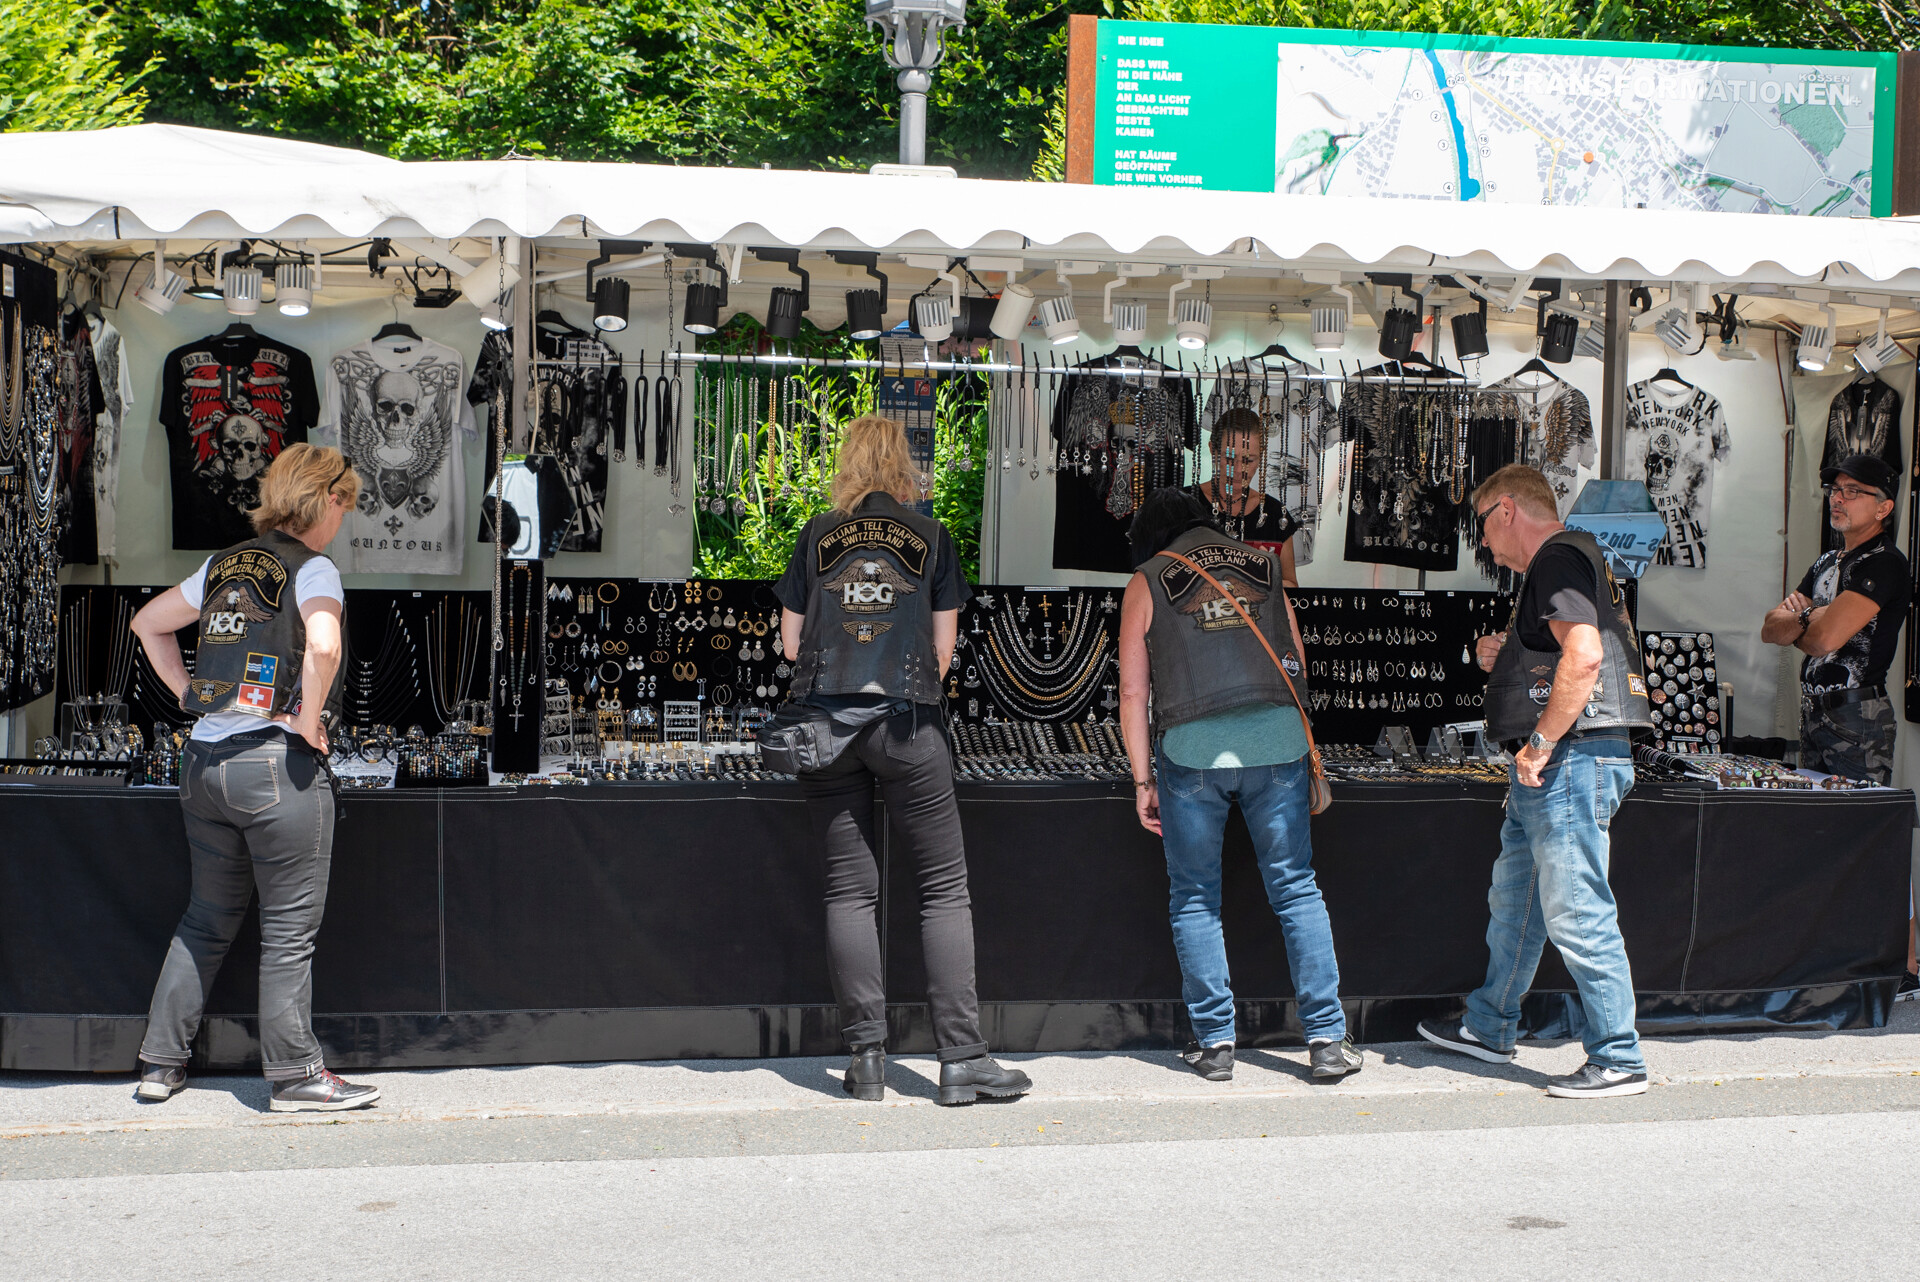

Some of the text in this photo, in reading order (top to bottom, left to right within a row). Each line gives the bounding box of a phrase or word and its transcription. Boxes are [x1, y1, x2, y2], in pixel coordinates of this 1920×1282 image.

[1118, 36, 1164, 46] DIE IDEE
[1117, 58, 1169, 70] DASS WIR
[1117, 70, 1183, 82] IN DIE NÄHE
[1116, 81, 1139, 91] DER
[1116, 92, 1191, 104] AN DAS LICHT
[1116, 104, 1189, 116] GEBRACHTEN
[1116, 116, 1151, 126] RESTE
[1116, 127, 1154, 137] KAMEN
[1115, 149, 1177, 161] HAT RÄUME
[1115, 160, 1171, 172] GEÖFFNET
[1115, 172, 1202, 184] DIE WIR VORHER
[821, 522, 924, 552] WILLIAM TELL CHAPTER
[842, 531, 904, 548] SWITZERLAND
[209, 553, 284, 583] WILLIAM TELL CHAPTER
[1165, 548, 1264, 579] WILLM TELL CHAPTER
[1184, 555, 1247, 574] SITZERLAND
[221, 563, 267, 580] SWITZERLAND
[844, 582, 894, 604] HOG
[207, 612, 246, 635] HOG
